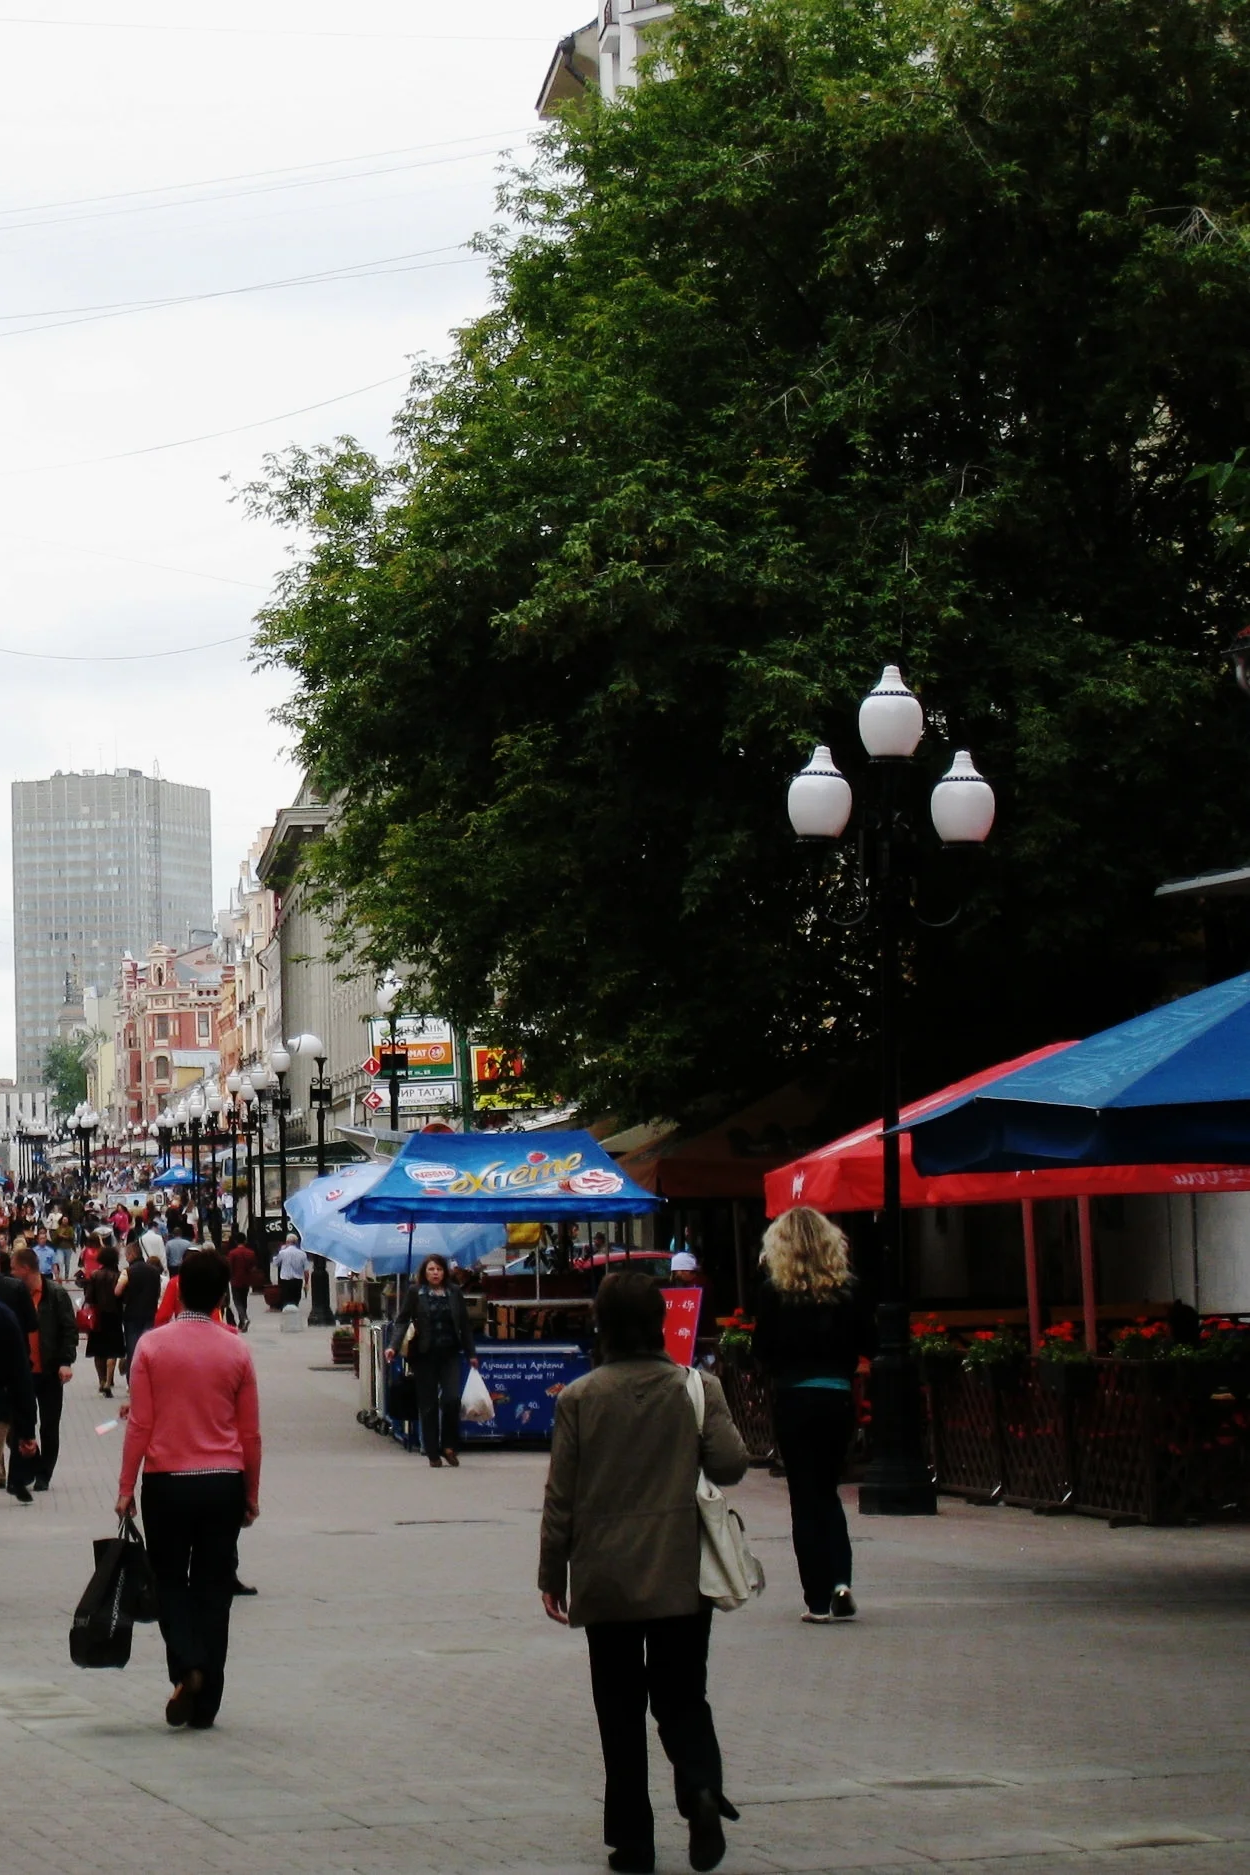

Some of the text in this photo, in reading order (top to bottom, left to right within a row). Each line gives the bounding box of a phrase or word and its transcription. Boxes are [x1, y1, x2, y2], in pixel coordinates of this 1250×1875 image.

[418, 1087, 445, 1097] ТАТУ
[481, 1361, 514, 1371] Лучшее
[529, 1361, 565, 1371] Арбате
[493, 1372, 522, 1380] низкой
[524, 1373, 543, 1381] цене
